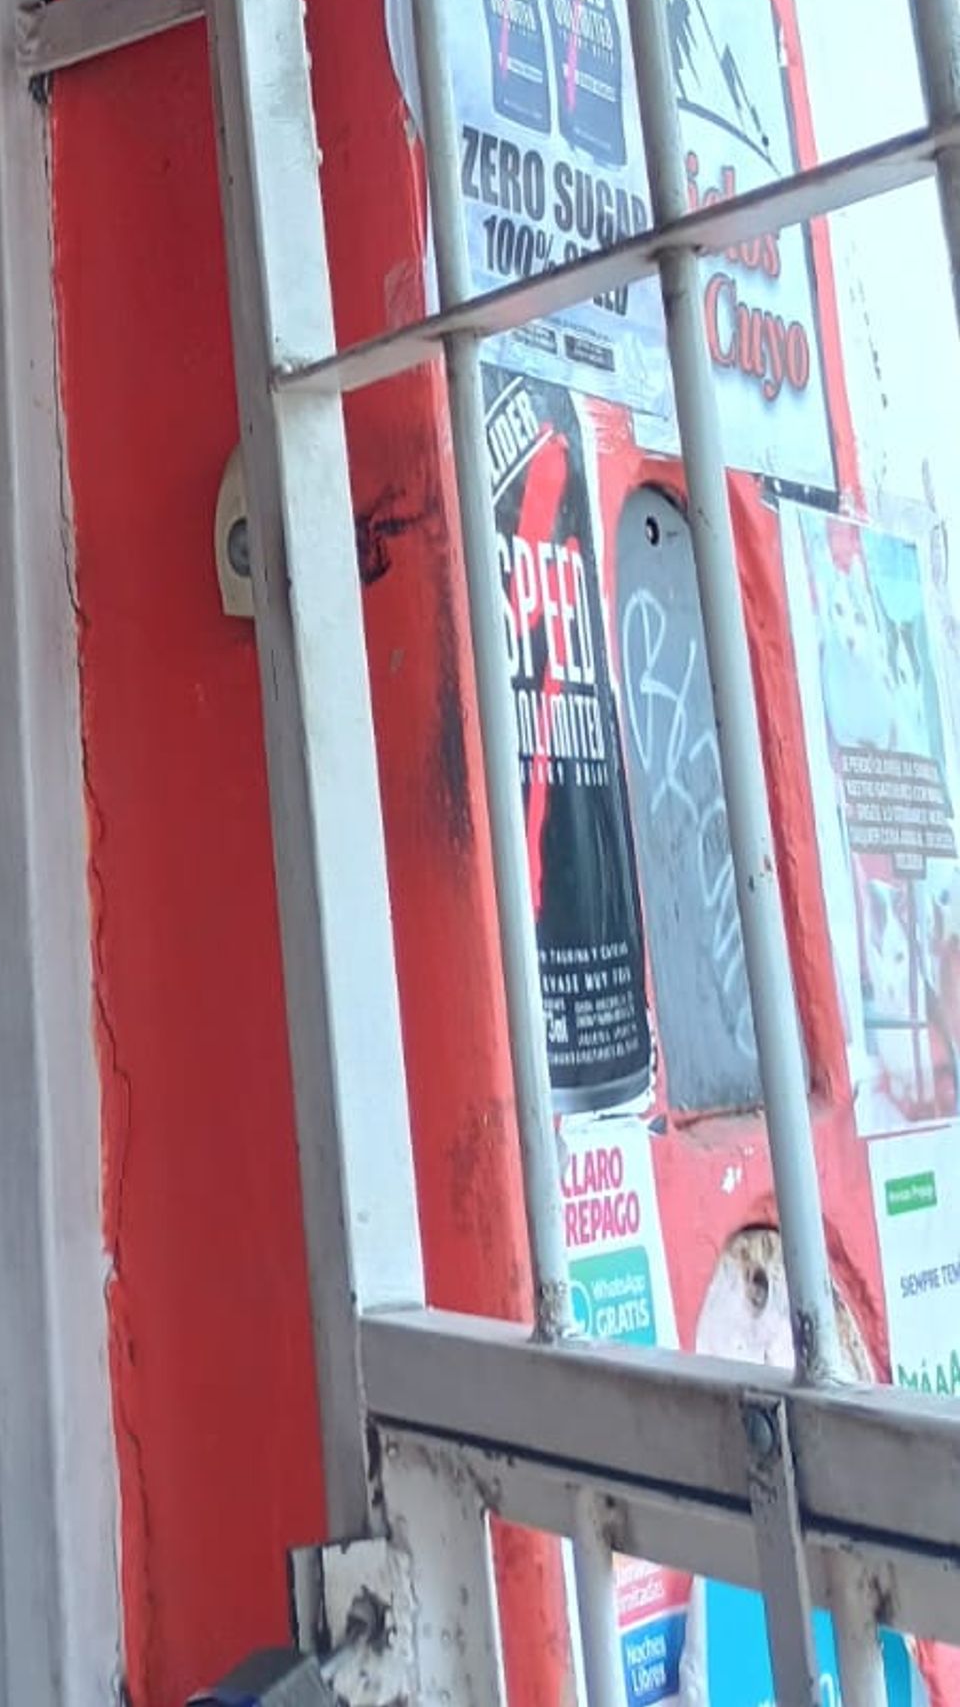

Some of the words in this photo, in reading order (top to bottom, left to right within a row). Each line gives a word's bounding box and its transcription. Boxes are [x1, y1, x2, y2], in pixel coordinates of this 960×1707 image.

[461, 124, 546, 223] ZERO
[483, 213, 555, 278] 100%
[704, 271, 810, 402] Cuyo
[496, 531, 596, 687] SPEED
[517, 689, 606, 760] NLIMITED
[560, 1146, 623, 1198] CLARO
[564, 1190, 640, 1248] REPAGO
[596, 1298, 650, 1336] GRATIS
